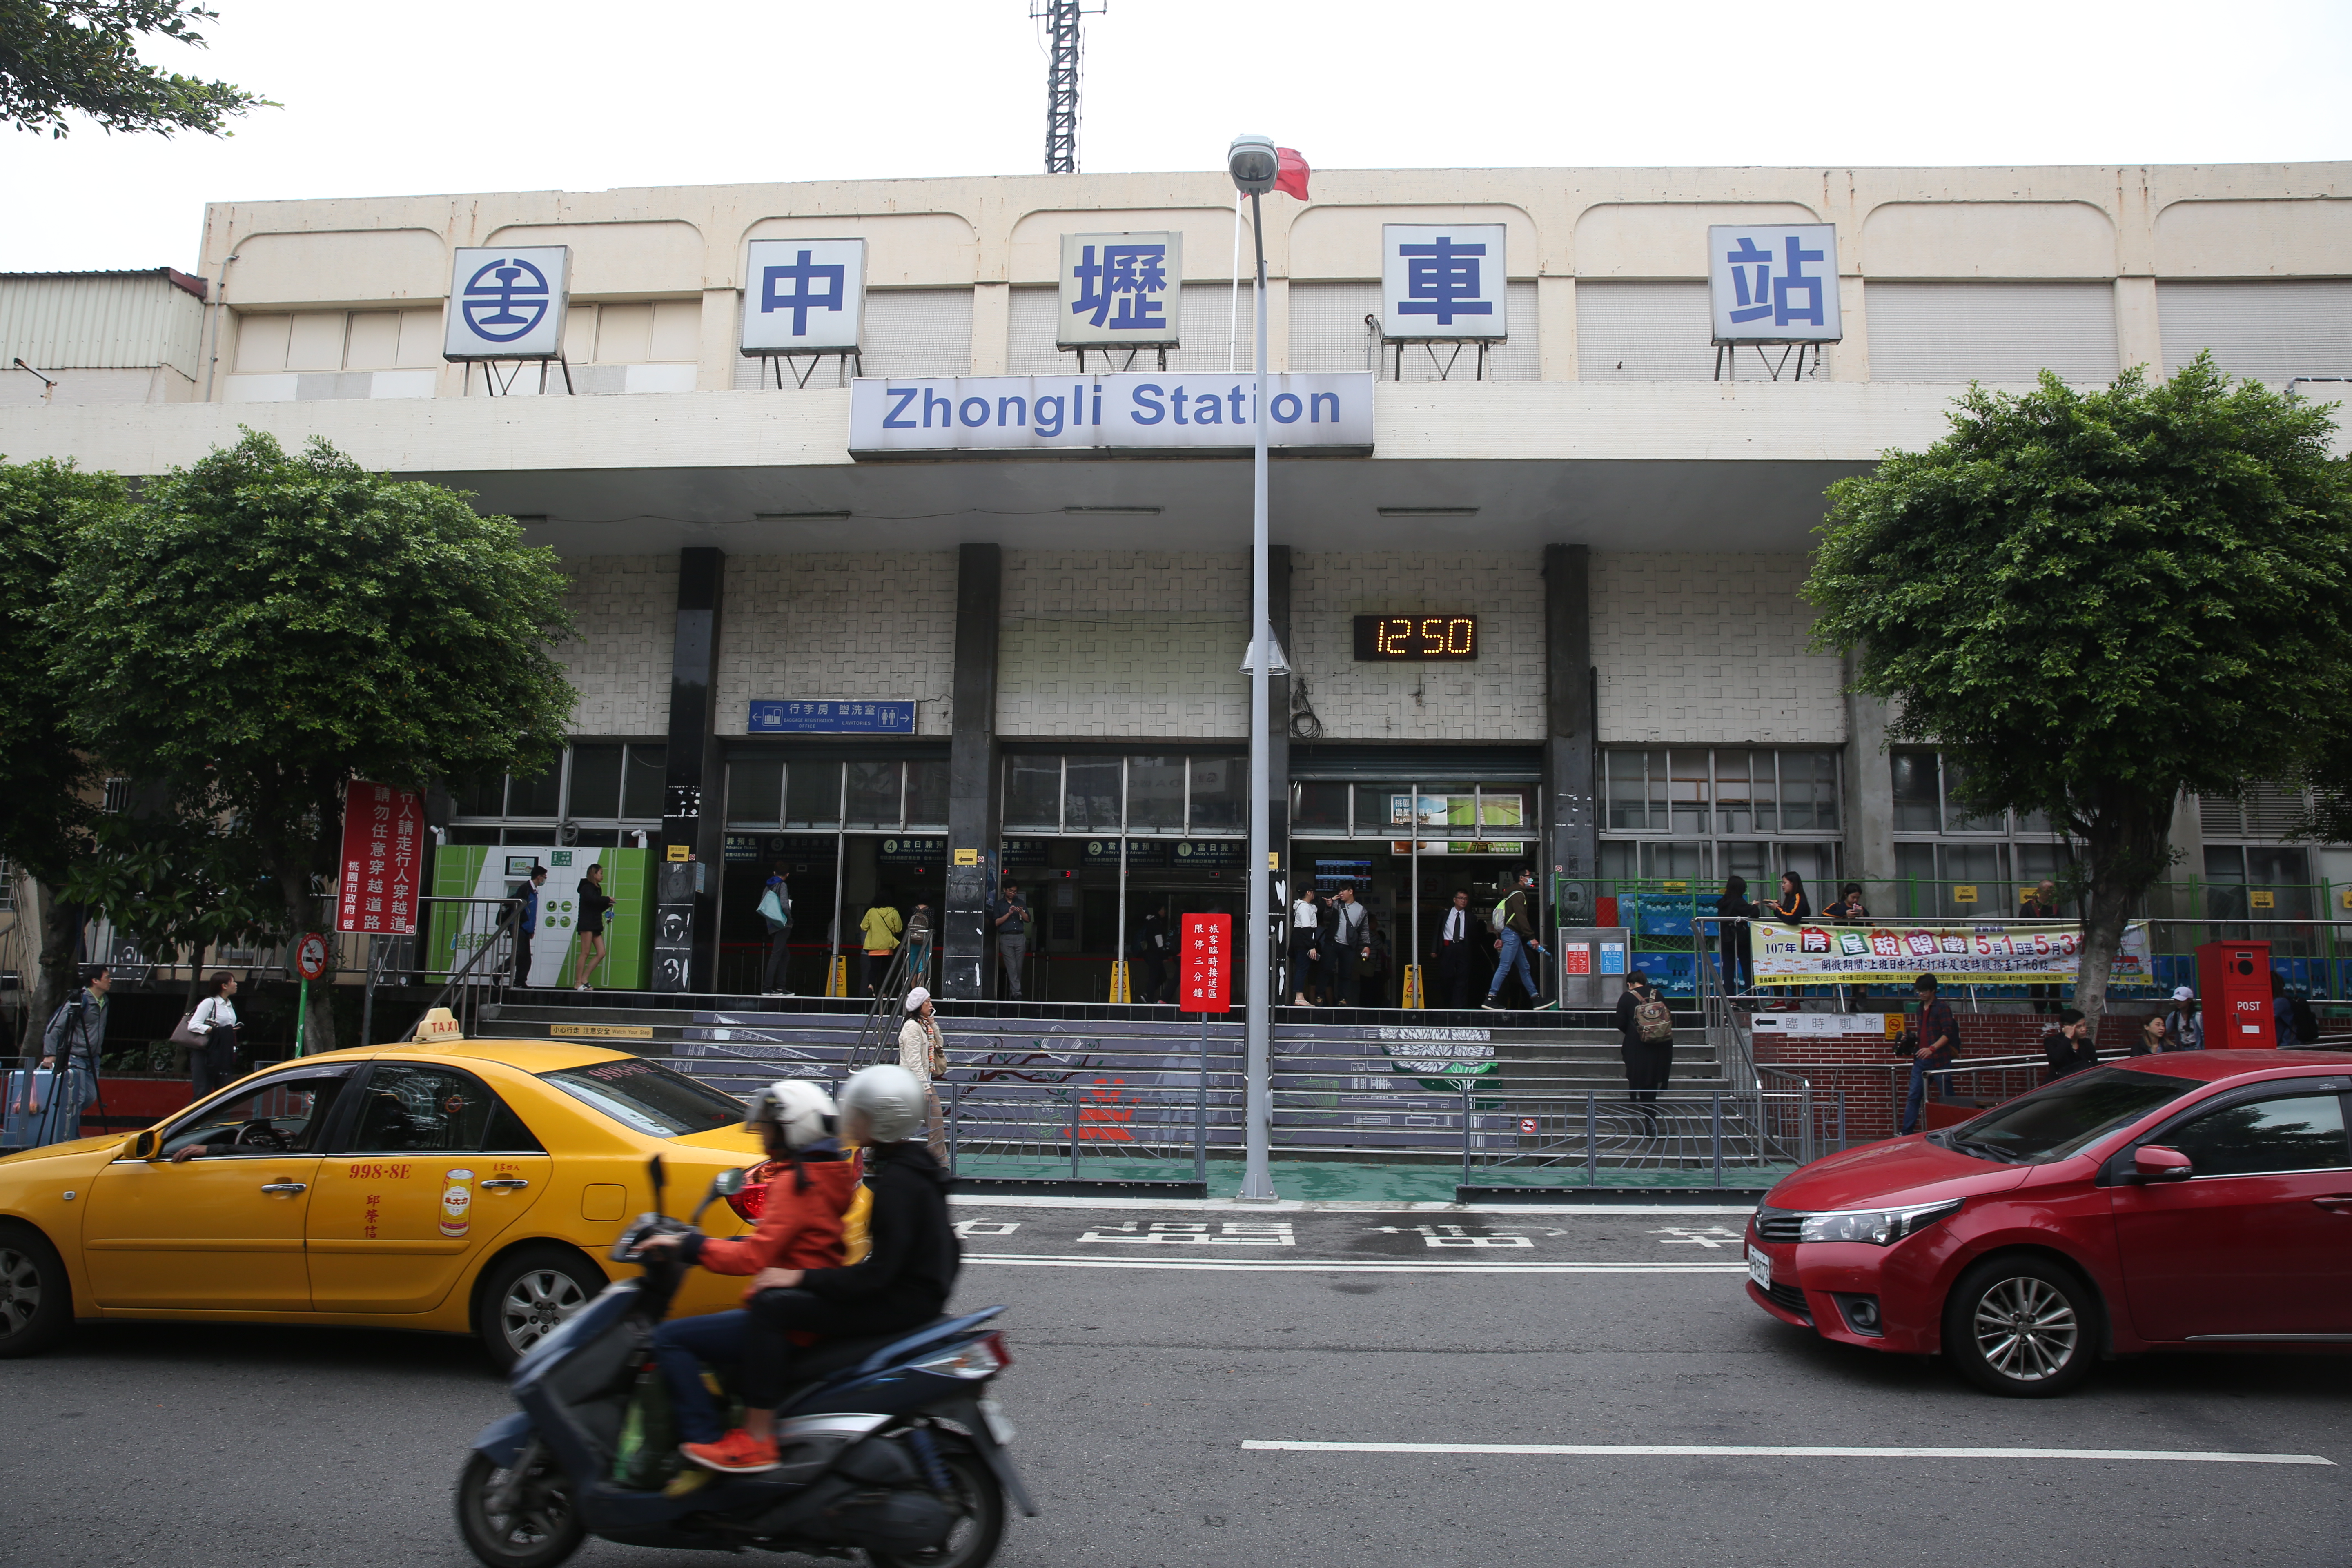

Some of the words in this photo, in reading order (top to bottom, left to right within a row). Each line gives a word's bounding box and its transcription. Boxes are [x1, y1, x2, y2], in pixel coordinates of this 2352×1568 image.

[761, 250, 845, 336] 中
[1071, 245, 1167, 330] 壢
[1397, 236, 1493, 325] 車
[1726, 236, 1824, 326] 站
[882, 384, 1102, 437] Zhongli
[789, 704, 829, 715] 行李房
[838, 704, 875, 715] 盥洗室
[1395, 798, 1410, 807] 桃園
[1395, 808, 1432, 817] 農業覽會
[726, 837, 756, 846] 兼預售
[774, 840, 780, 849] 5
[887, 842, 894, 851] 4
[903, 840, 944, 849] 當日兼預
[1108, 842, 1161, 851] 當兼預售
[1092, 843, 1098, 853] 2
[1182, 845, 1186, 854] 1
[364, 786, 391, 930] 請勿任意穿越道路
[390, 790, 416, 931] 行人請走行人穿越道
[344, 861, 359, 915] 桃園市政府
[1765, 942, 1797, 954] 107年
[1804, 933, 1967, 956] 房屋稅開徵
[1192, 924, 1205, 998] 限停三分鐘
[1207, 924, 1220, 998] 旅客臨時接送區
[2237, 1001, 2261, 1011] POST
[431, 1021, 458, 1033] TAXI
[1785, 1017, 1878, 1030] 臨時廁所
[364, 1194, 380, 1238] 邱榮信
